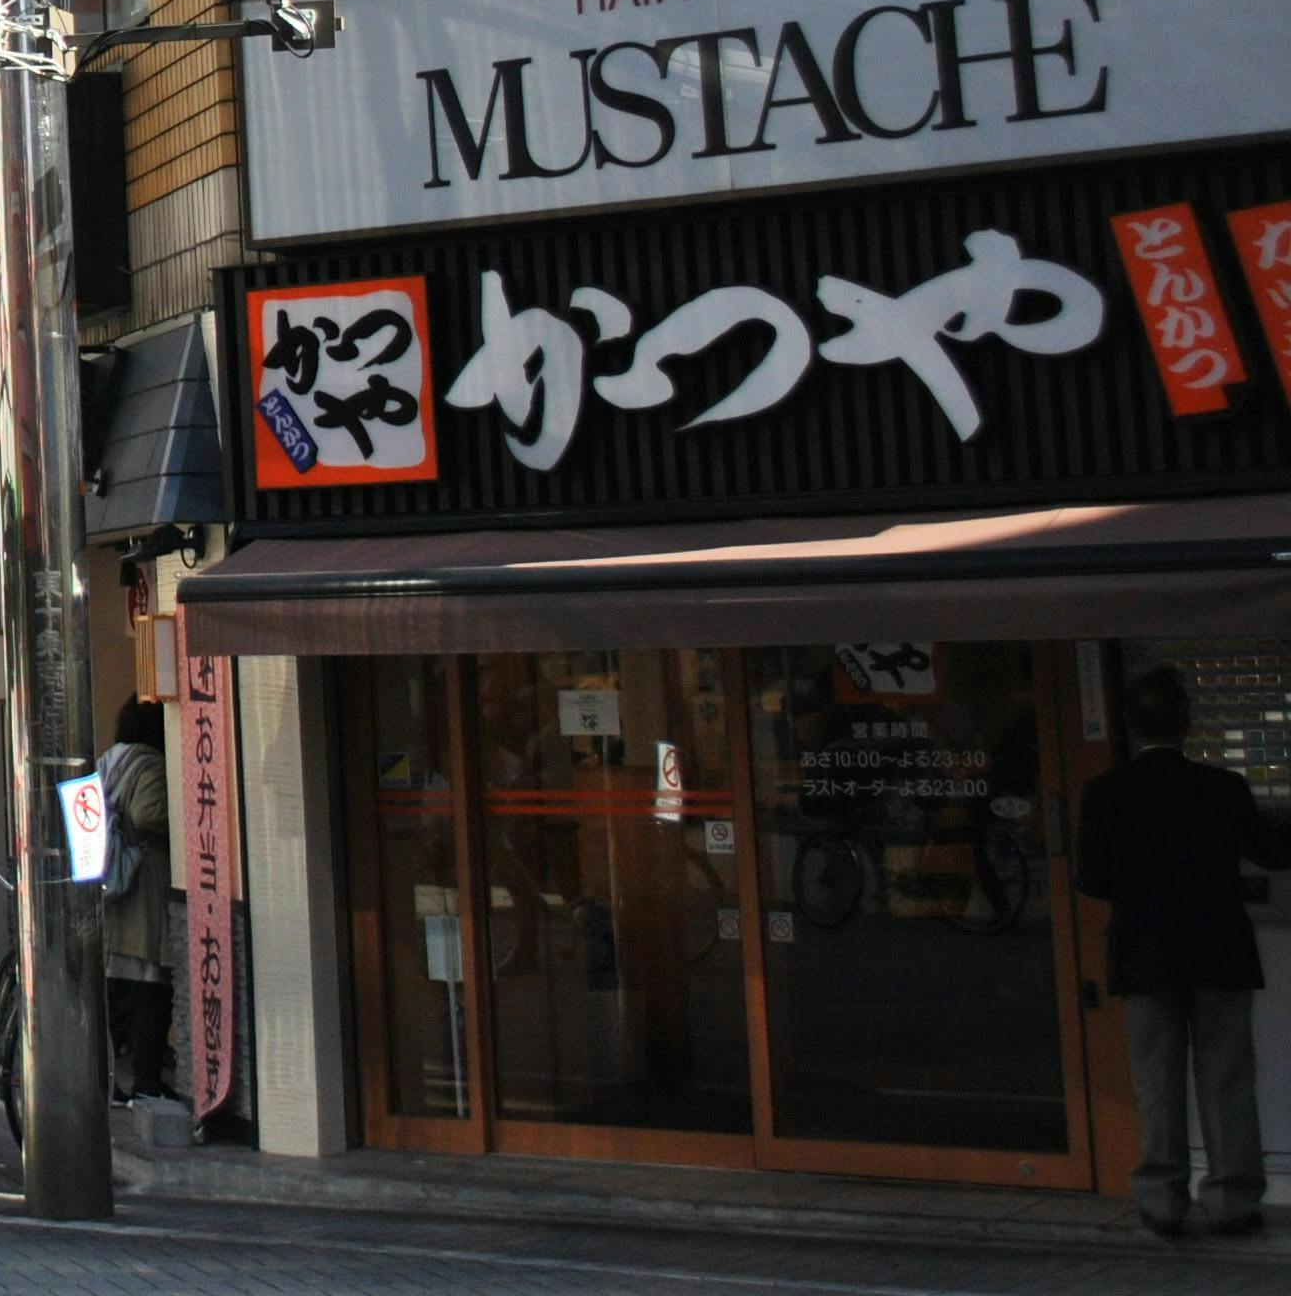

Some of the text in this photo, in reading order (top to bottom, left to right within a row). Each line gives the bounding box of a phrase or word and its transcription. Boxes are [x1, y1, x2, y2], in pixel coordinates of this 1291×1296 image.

[444, 227, 1106, 472] かつや
[1126, 216, 1228, 389] とんかつ
[261, 394, 313, 466] とんかつ
[33, 569, 66, 757] 東十条商店街
[801, 778, 988, 798] ラストオーダーよる23:00
[850, 720, 929, 739] 営業時間
